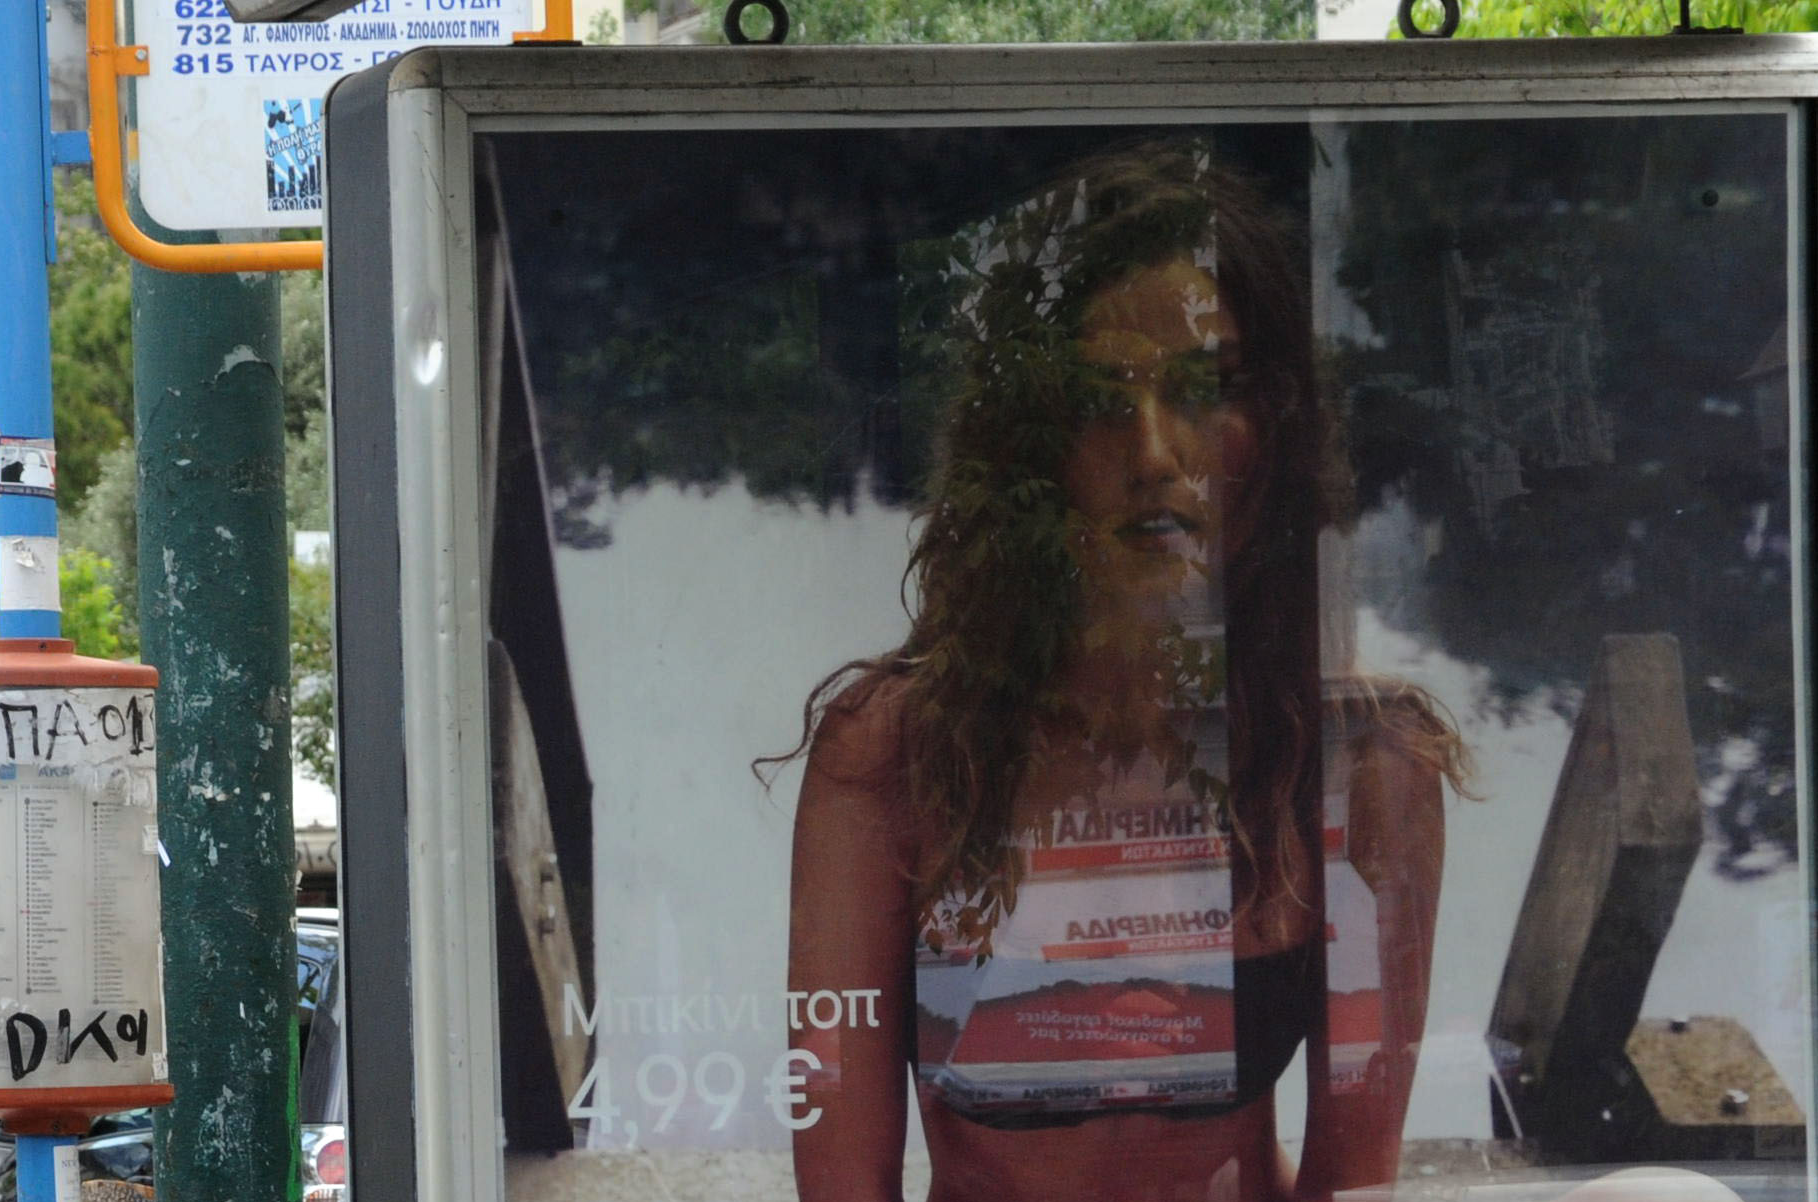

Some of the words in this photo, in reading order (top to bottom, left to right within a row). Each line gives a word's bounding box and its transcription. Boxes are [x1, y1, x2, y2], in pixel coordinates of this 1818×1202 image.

[176, 23, 232, 46] 732
[243, 24, 260, 43] ΑΓ.
[265, 23, 330, 43] ΦΑΝΟΥΡΙΟΣ
[339, 22, 398, 41] ΑΚΑΔΗΜΙΑ
[406, 20, 467, 40] ΖΩΟΔΟΧΟΣ
[469, 19, 500, 39] ΠΗΓΗ
[173, 53, 234, 75] 815
[244, 52, 344, 73] ΤΑΥΡΟΣ
[782, 988, 881, 1030] τοπ
[567, 1050, 746, 1148] 4,99
[763, 1048, 823, 1131] €
